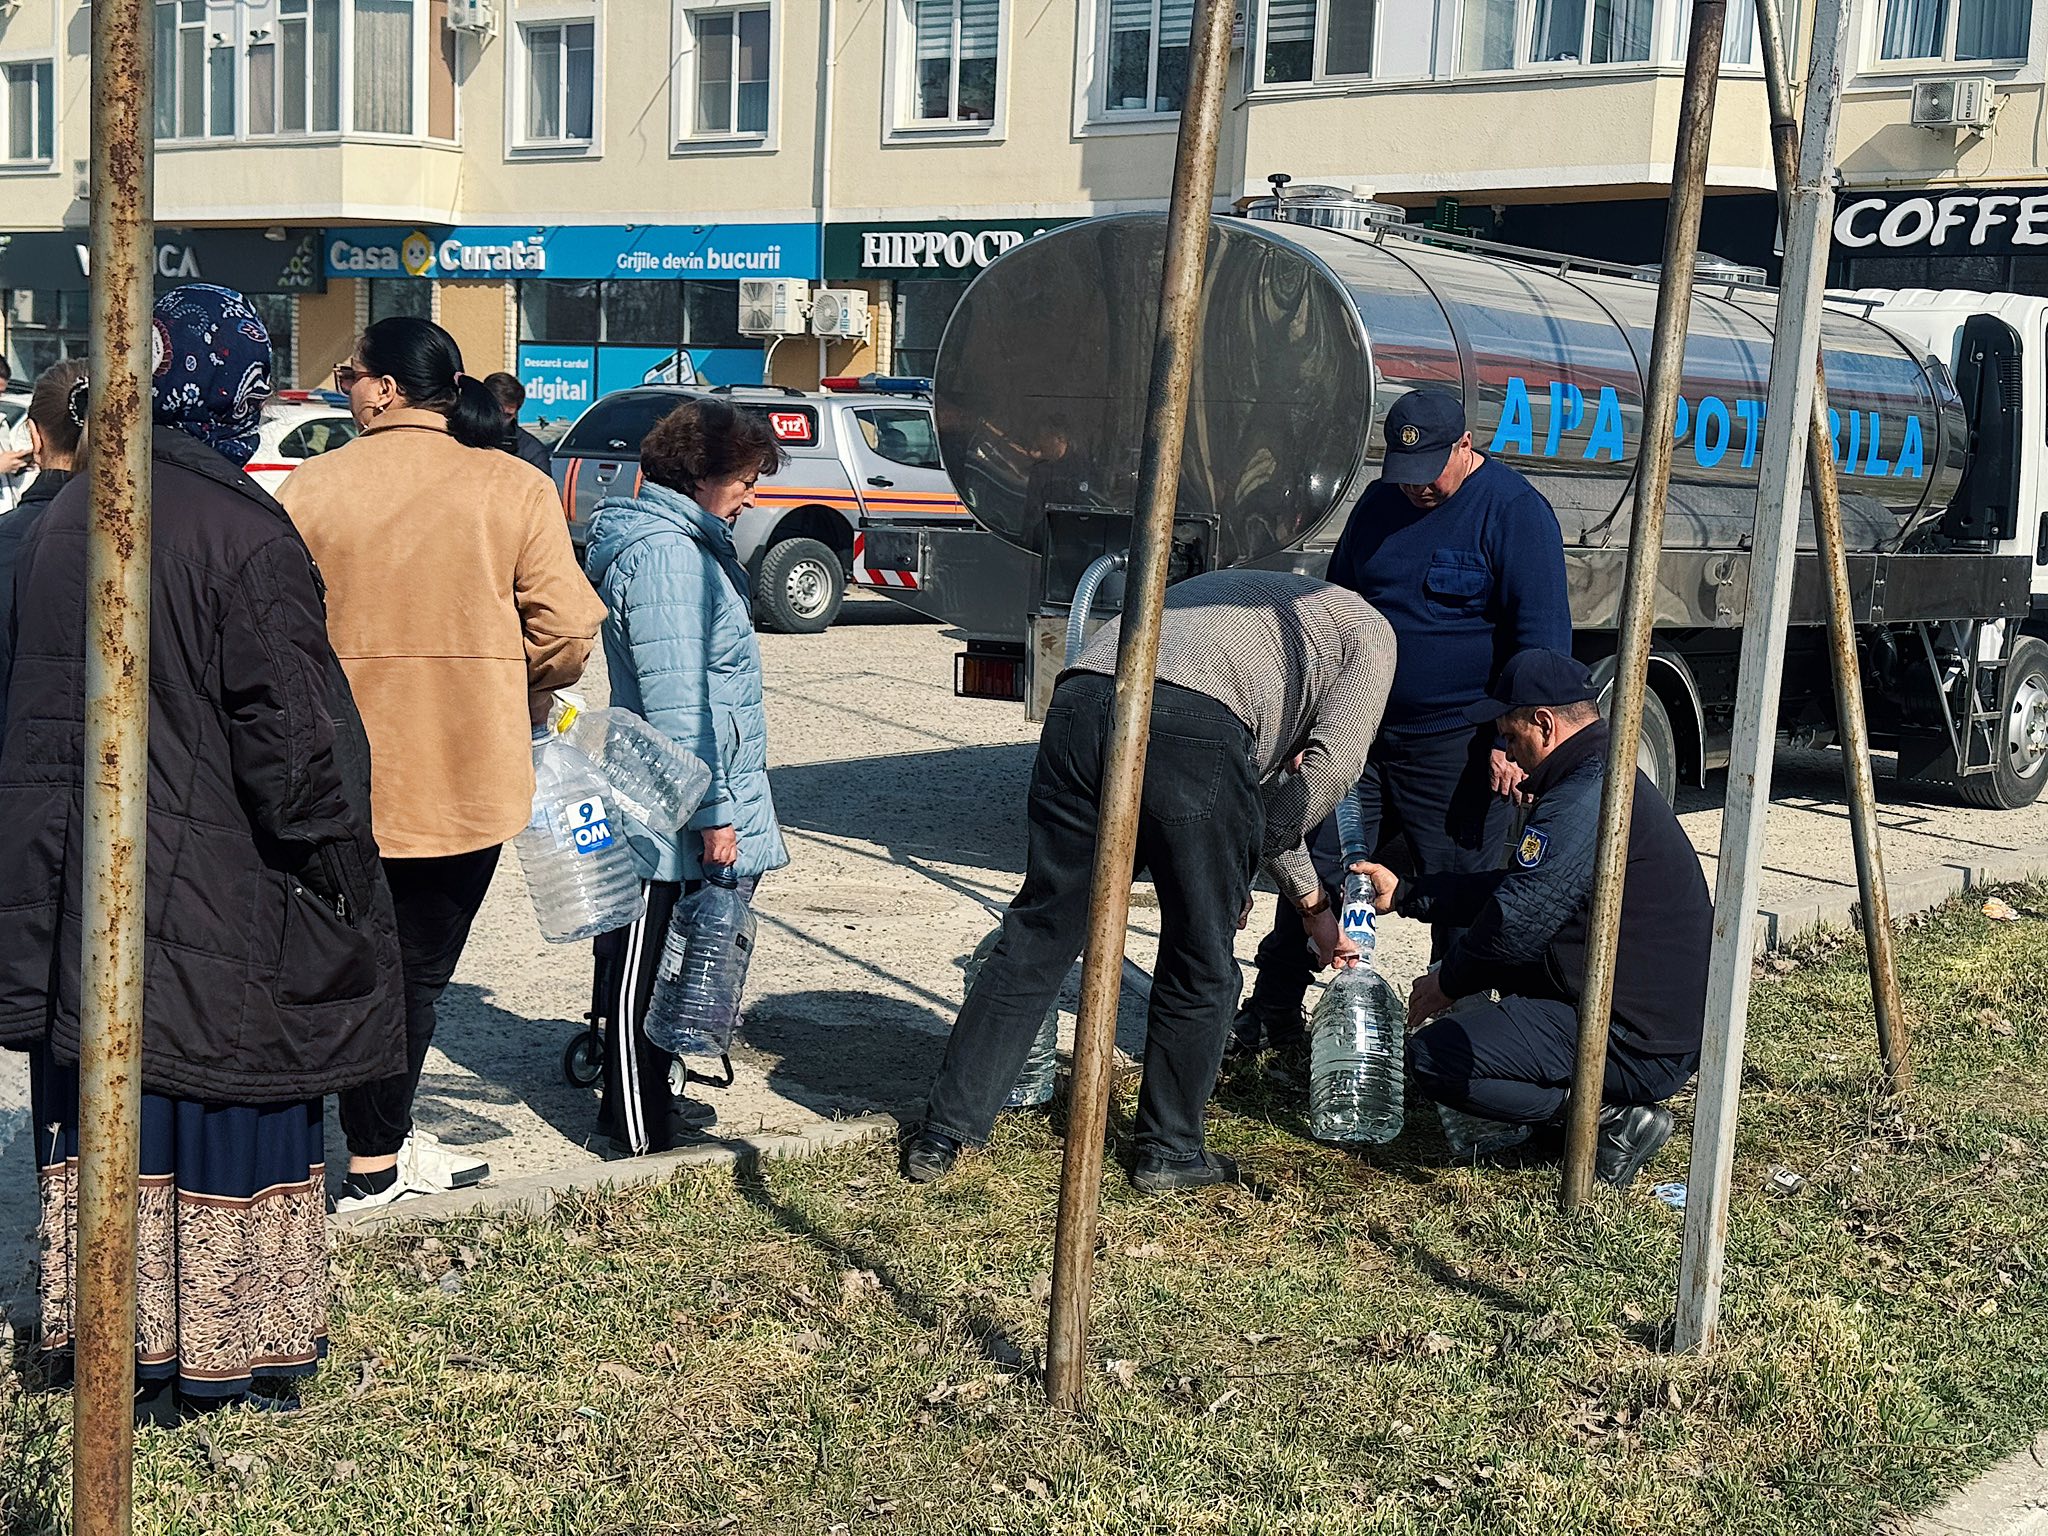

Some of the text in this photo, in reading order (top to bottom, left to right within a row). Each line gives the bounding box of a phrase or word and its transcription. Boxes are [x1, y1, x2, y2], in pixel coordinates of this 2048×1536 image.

[330, 236, 547, 271] Casa Curată
[616, 245, 781, 273] Grijile devin bucurii
[563, 358, 589, 369] cardul
[525, 376, 587, 405] digital
[780, 418, 802, 432] 112
[1488, 376, 1625, 461] APA
[575, 822, 612, 847] OM
